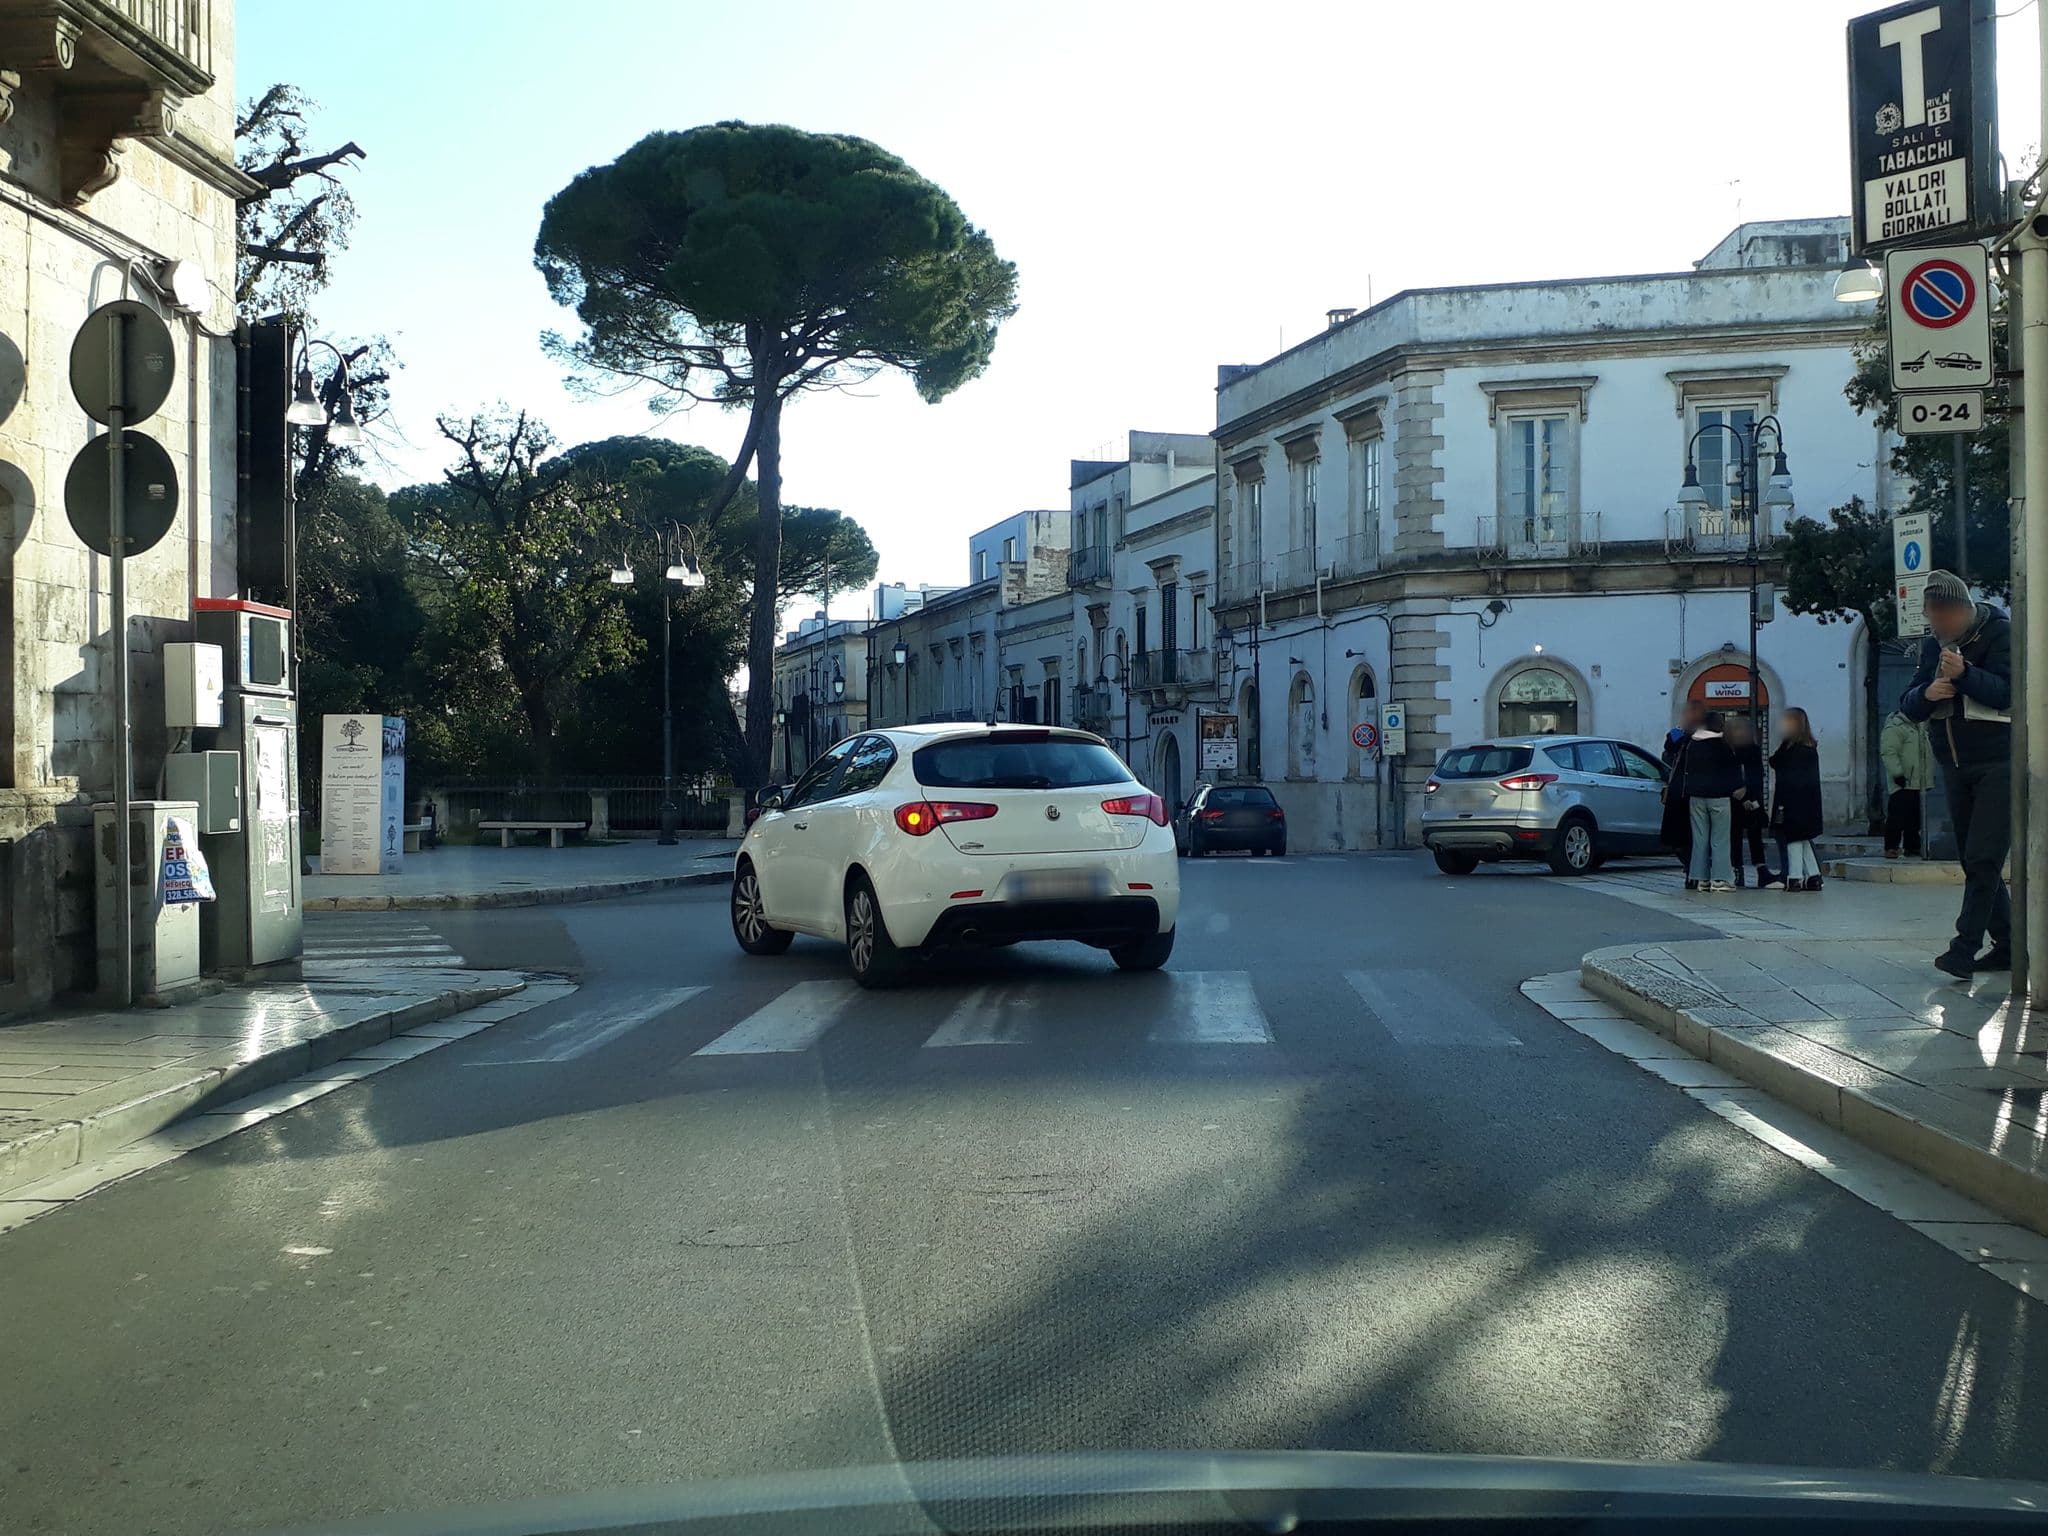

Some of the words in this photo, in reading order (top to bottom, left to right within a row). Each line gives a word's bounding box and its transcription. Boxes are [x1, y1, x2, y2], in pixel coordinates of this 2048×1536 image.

[1879, 6, 1941, 129] T
[1930, 107, 1948, 124] 13
[1892, 132, 1924, 148] SALI
[1935, 126, 1942, 138] E
[1879, 140, 1953, 174] TABACCHI
[1885, 170, 1946, 199] VALORI
[1885, 192, 1947, 220] BOLLATI
[1882, 207, 1951, 239] GIORNALI
[1912, 403, 1970, 423] 0-24
